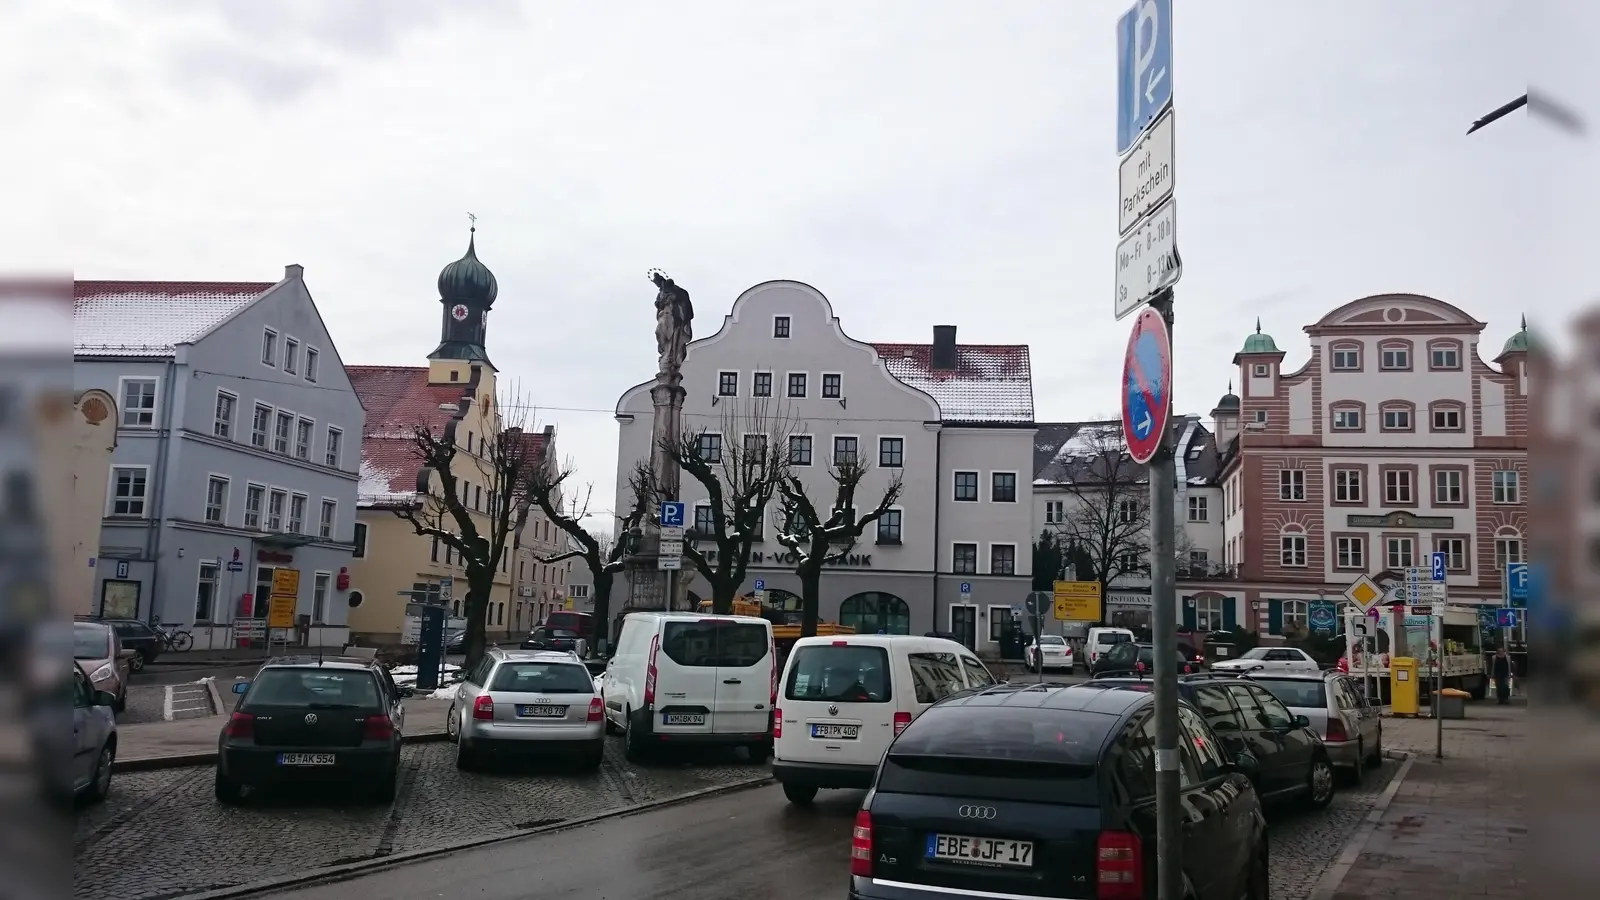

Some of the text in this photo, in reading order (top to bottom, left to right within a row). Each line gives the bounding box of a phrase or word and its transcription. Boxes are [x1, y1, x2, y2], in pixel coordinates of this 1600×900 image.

[1138, 153, 1152, 178] mit
[1123, 163, 1169, 217] Parkschein
[1119, 284, 1128, 302] Sa
[524, 706, 538, 714] EBE
[816, 725, 856, 736] FFB PK 406
[282, 754, 334, 764] MB AK 554
[935, 836, 1032, 863] EBE JF 17
